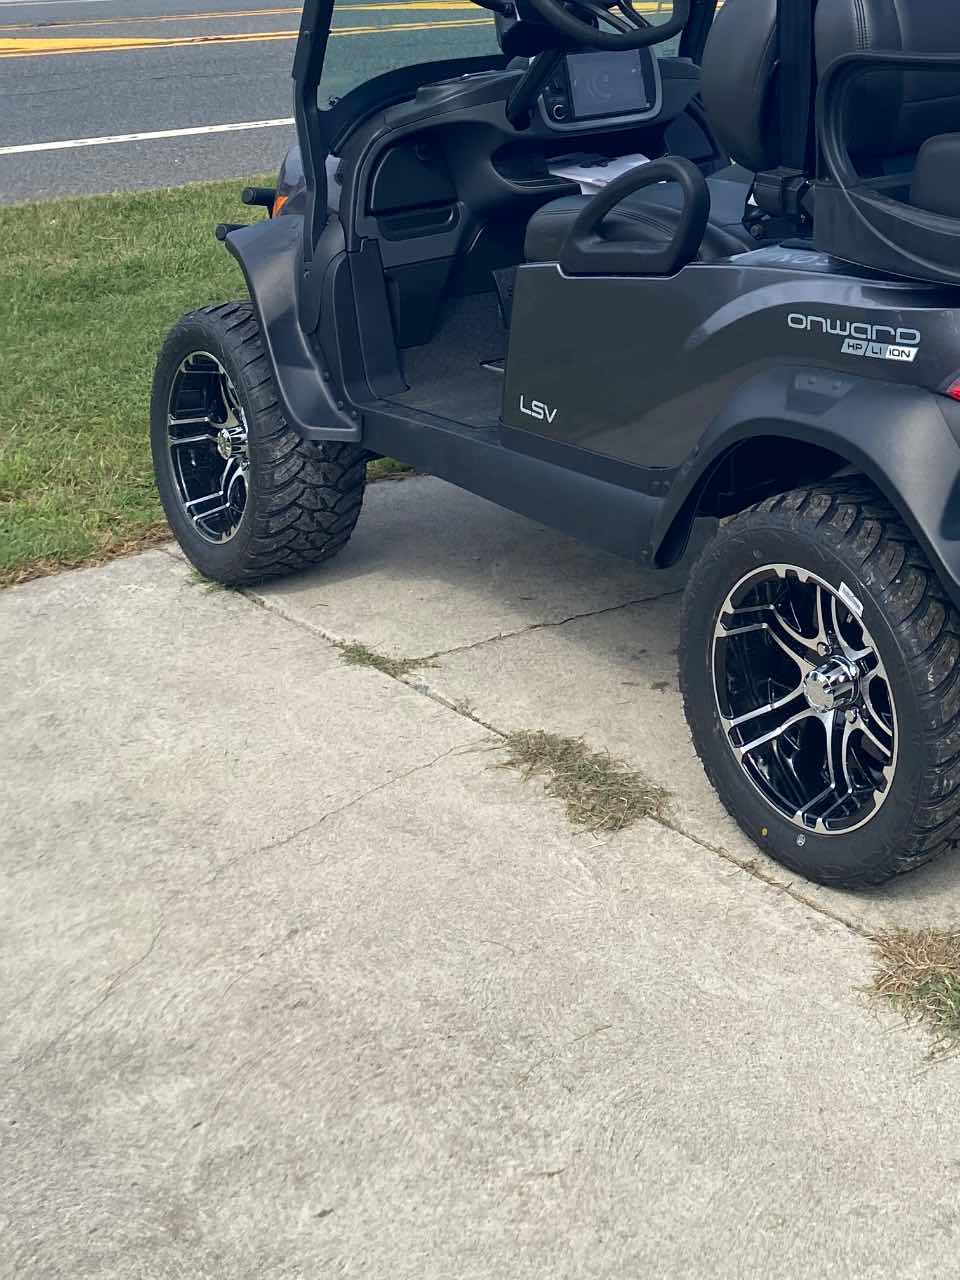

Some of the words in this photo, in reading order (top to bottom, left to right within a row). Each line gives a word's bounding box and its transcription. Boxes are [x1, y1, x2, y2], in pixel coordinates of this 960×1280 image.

[847, 342, 863, 351] HP
[888, 347, 911, 358] ION
[520, 395, 557, 423] LSV
